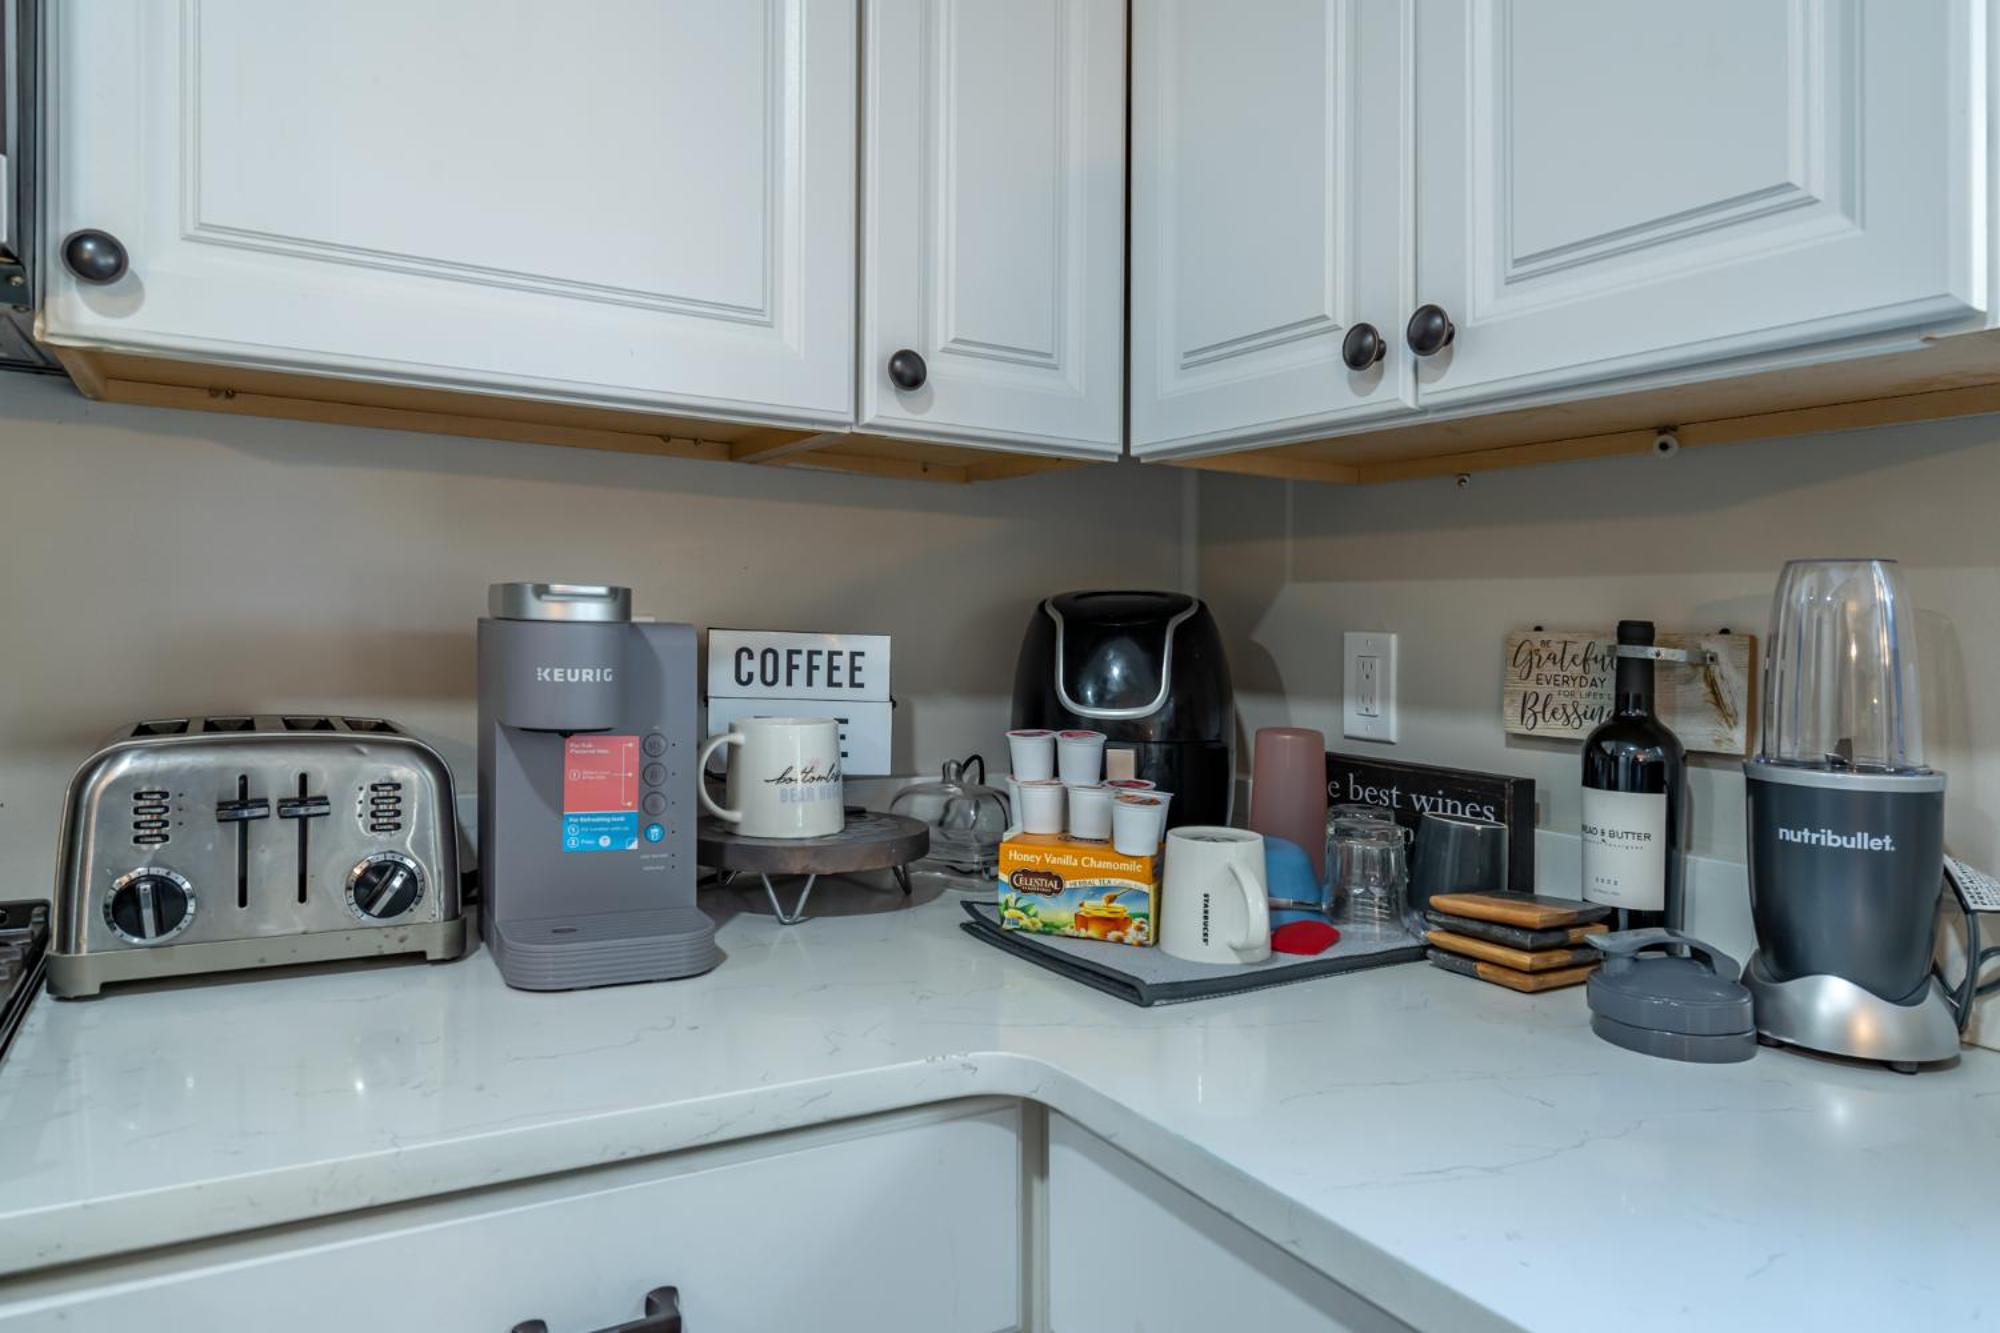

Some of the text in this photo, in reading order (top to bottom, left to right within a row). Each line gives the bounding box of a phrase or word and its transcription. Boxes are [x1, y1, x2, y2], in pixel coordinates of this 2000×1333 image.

[536, 666, 614, 682] KEURIG
[734, 646, 865, 689] COFFEE
[1536, 673, 1607, 689] EVERYDAY
[1520, 690, 1614, 732] Blessin
[1349, 772, 1401, 809] best
[1410, 789, 1496, 822] wines
[1608, 829, 1653, 842] BUTTER
[1008, 850, 1143, 873] Honey Vanilla Chamomile
[1012, 873, 1061, 890] CELESTIAL
